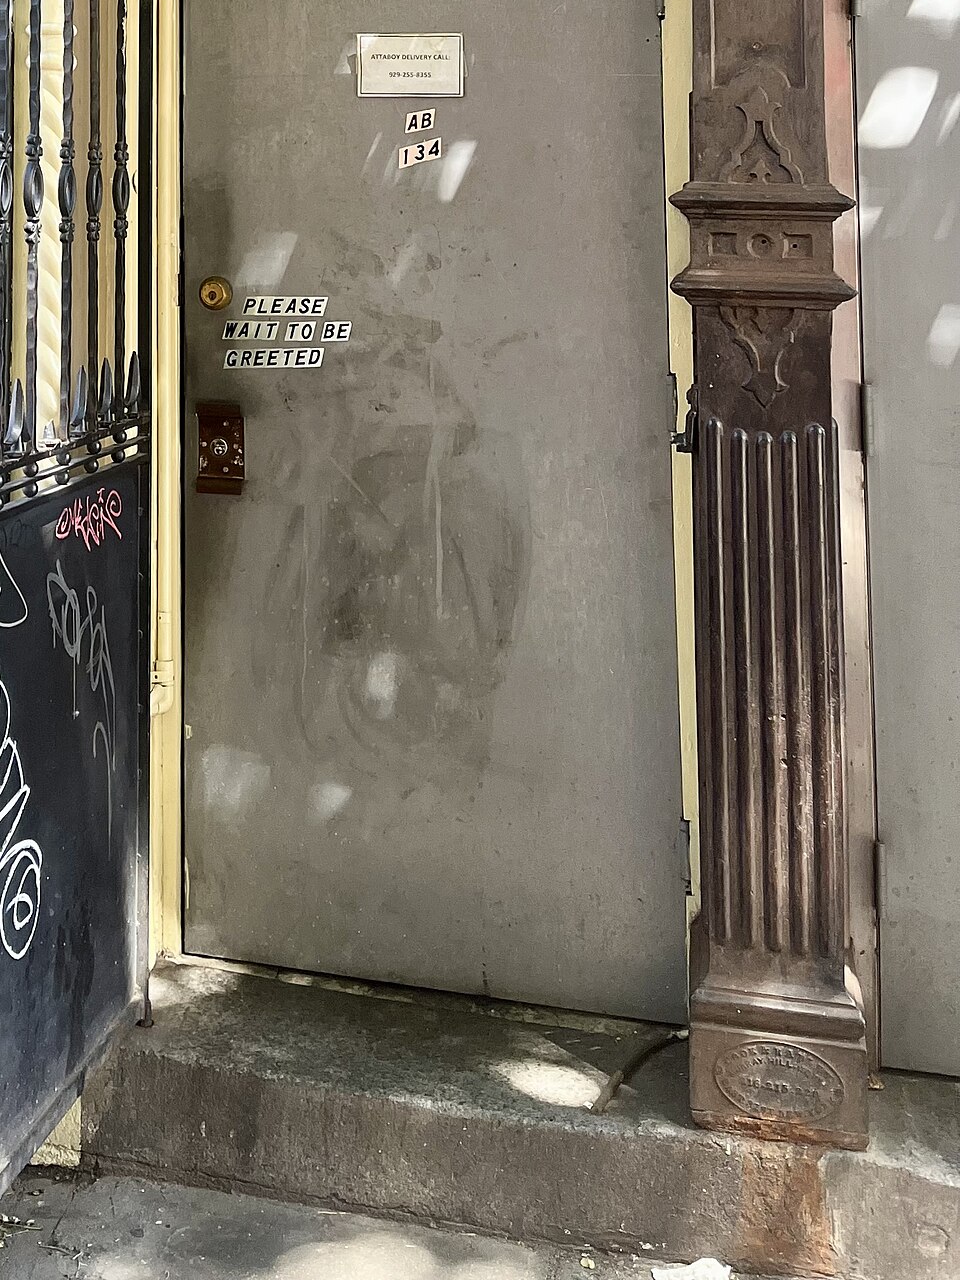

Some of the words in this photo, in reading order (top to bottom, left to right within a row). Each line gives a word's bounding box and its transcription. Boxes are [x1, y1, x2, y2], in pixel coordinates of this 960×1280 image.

[407, 112, 432, 131] AB
[403, 139, 440, 165] 134
[243, 298, 325, 315] PLEASE
[224, 322, 278, 339] WAIT
[288, 323, 314, 340] TO
[323, 323, 350, 339] BE
[226, 349, 321, 368] GREETED
